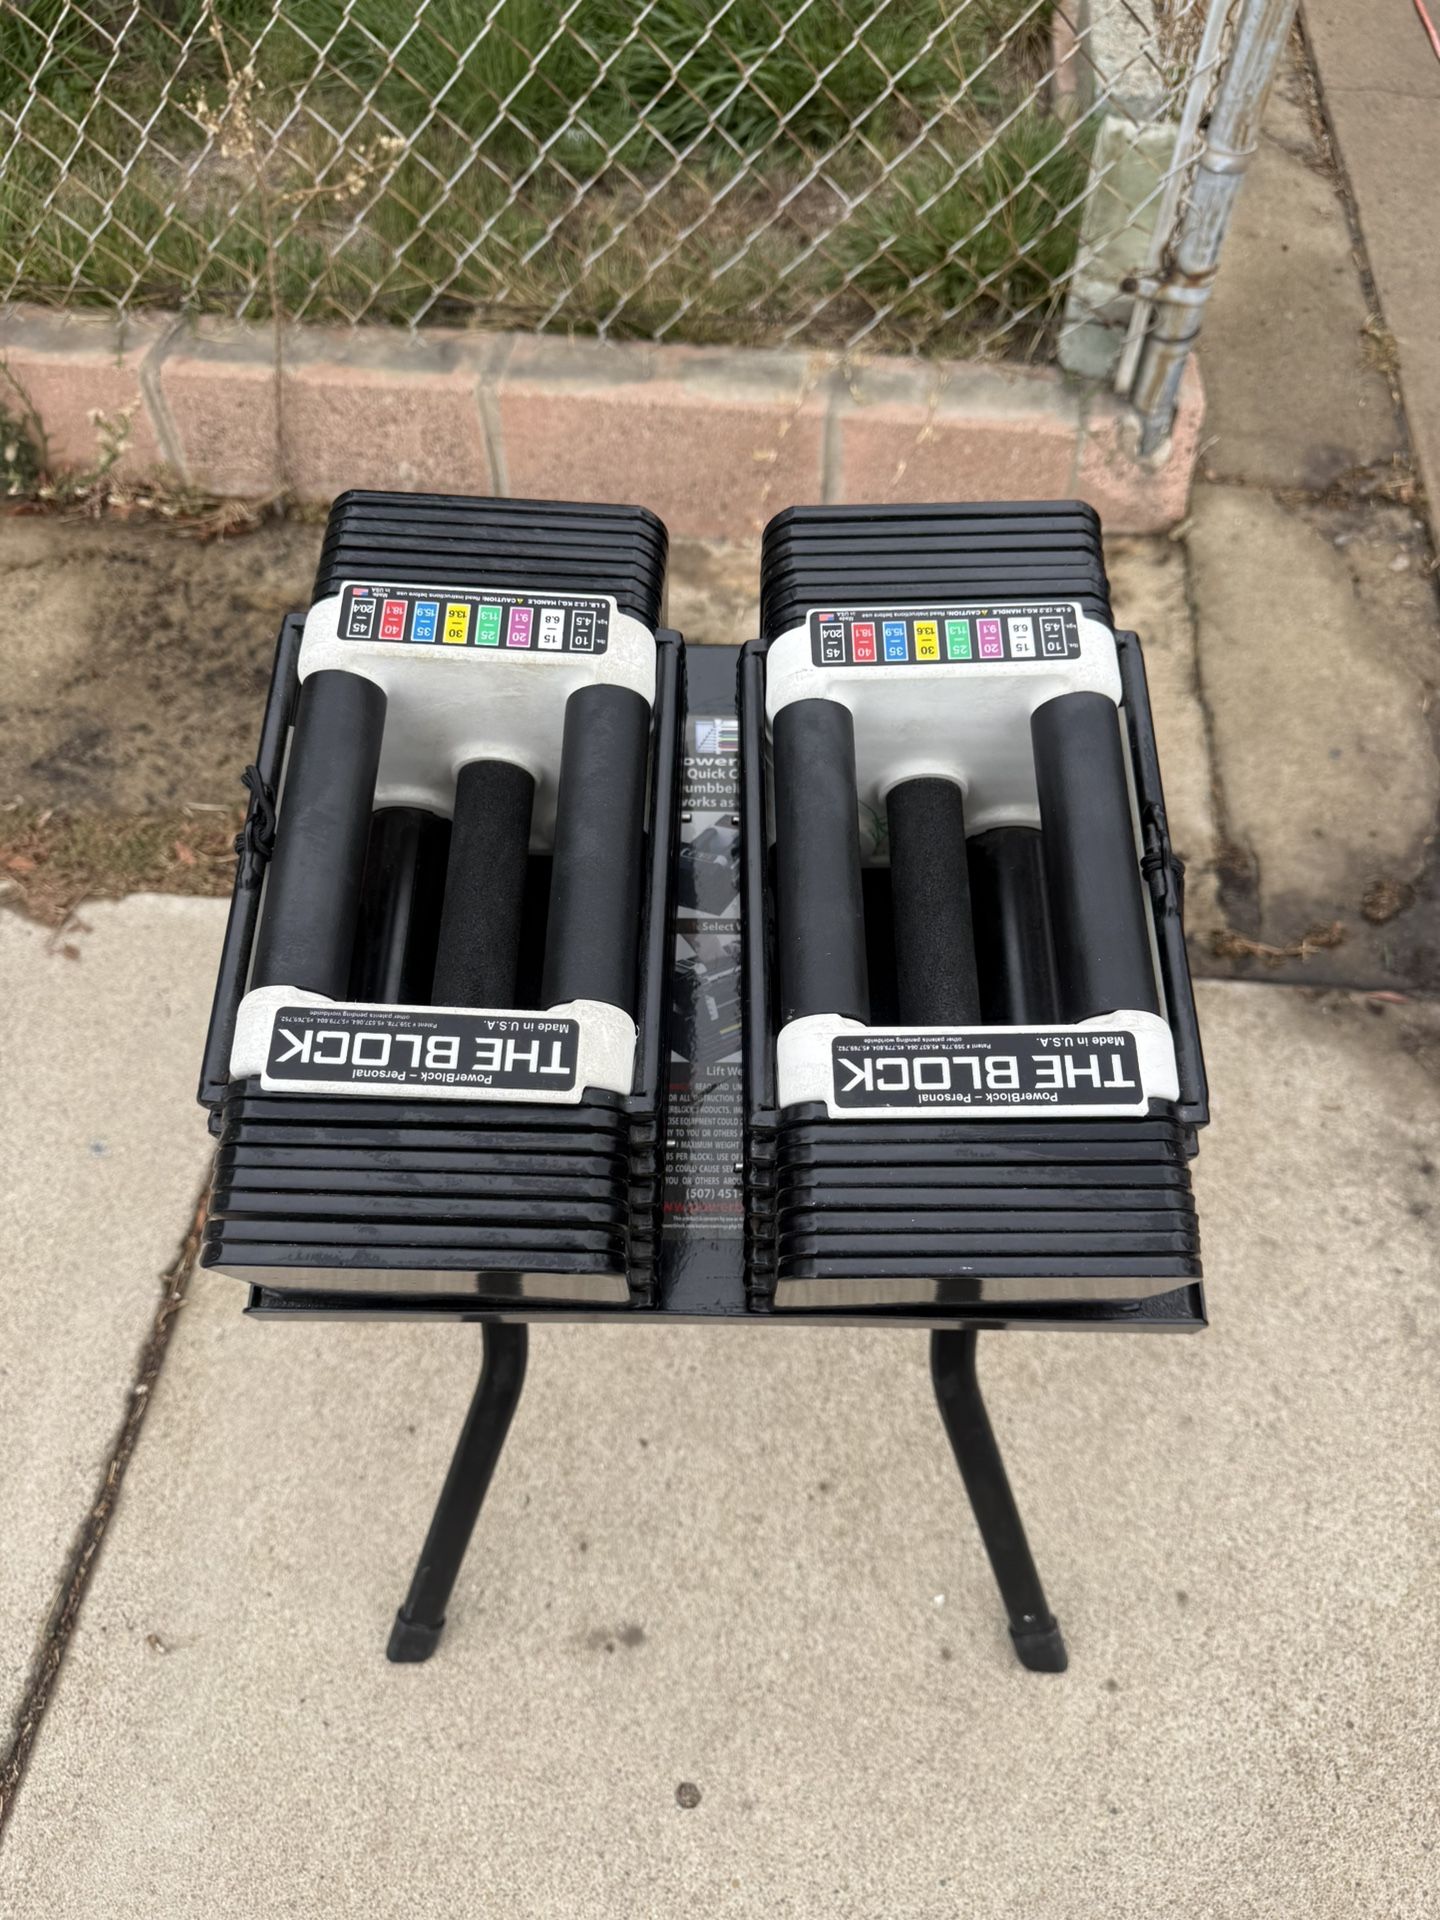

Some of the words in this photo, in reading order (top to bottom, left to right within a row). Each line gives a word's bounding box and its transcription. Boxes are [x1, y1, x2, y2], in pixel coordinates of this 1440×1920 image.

[354, 604, 373, 613] 20.4
[387, 606, 404, 614] 18.1
[416, 608, 435, 616] 15.9
[449, 610, 466, 618] 13.6
[481, 612, 497, 620] 11.3
[515, 614, 528, 622] 9.1
[545, 616, 560, 624] 6.8
[576, 617, 592, 626] 4.5
[352, 624, 367, 632] 45
[385, 625, 399, 634] 40
[417, 627, 431, 636] 35
[950, 626, 967, 634] 11.3
[983, 625, 996, 633] 9.1
[1013, 624, 1028, 632] 6.8
[1044, 623, 1060, 631] 4.5
[449, 629, 463, 638] 30
[481, 631, 495, 640] 25
[512, 632, 526, 641] 20
[823, 629, 842, 638] 20.4
[885, 628, 903, 636] 15.9
[544, 635, 556, 643] 15
[575, 636, 588, 645] 10
[921, 646, 934, 654] 30
[952, 645, 967, 654] 25
[984, 644, 998, 652] 20
[1048, 642, 1061, 650] 10
[826, 649, 840, 657] 45
[858, 648, 872, 656] 40
[889, 647, 903, 655] 35
[688, 768, 725, 780] Quick
[720, 799, 734, 807] as
[702, 922, 734, 931] Select
[483, 1020, 519, 1031] U.S.A.
[523, 1022, 534, 1032] in
[538, 1023, 569, 1033] Made
[1036, 1037, 1073, 1047] U.S.A.
[1077, 1037, 1088, 1046] in
[1092, 1036, 1125, 1046] Made
[275, 1029, 460, 1069] BLOCK
[472, 1037, 570, 1074] THE
[352, 1069, 405, 1081] Personal
[706, 1066, 725, 1076] Lift
[837, 1056, 1020, 1091] BLOCK
[1032, 1054, 1135, 1088] THE
[421, 1072, 492, 1084] PowerBlock
[693, 1094, 734, 1102] TRUCTION
[918, 1093, 971, 1103] Personal
[985, 1092, 1058, 1102] PowerBlock
[680, 1117, 716, 1125] EQUIPMENT
[717, 1117, 738, 1125] COULD
[676, 1129, 685, 1137] TO
[686, 1129, 700, 1137] YOU
[702, 1129, 711, 1137] OR
[713, 1129, 738, 1137] OTHERS
[715, 1141, 739, 1149] WEIGHT
[699, 1165, 720, 1173] CAUSE
[686, 1188, 715, 1198] (507)
[717, 1188, 743, 1198] 451-
